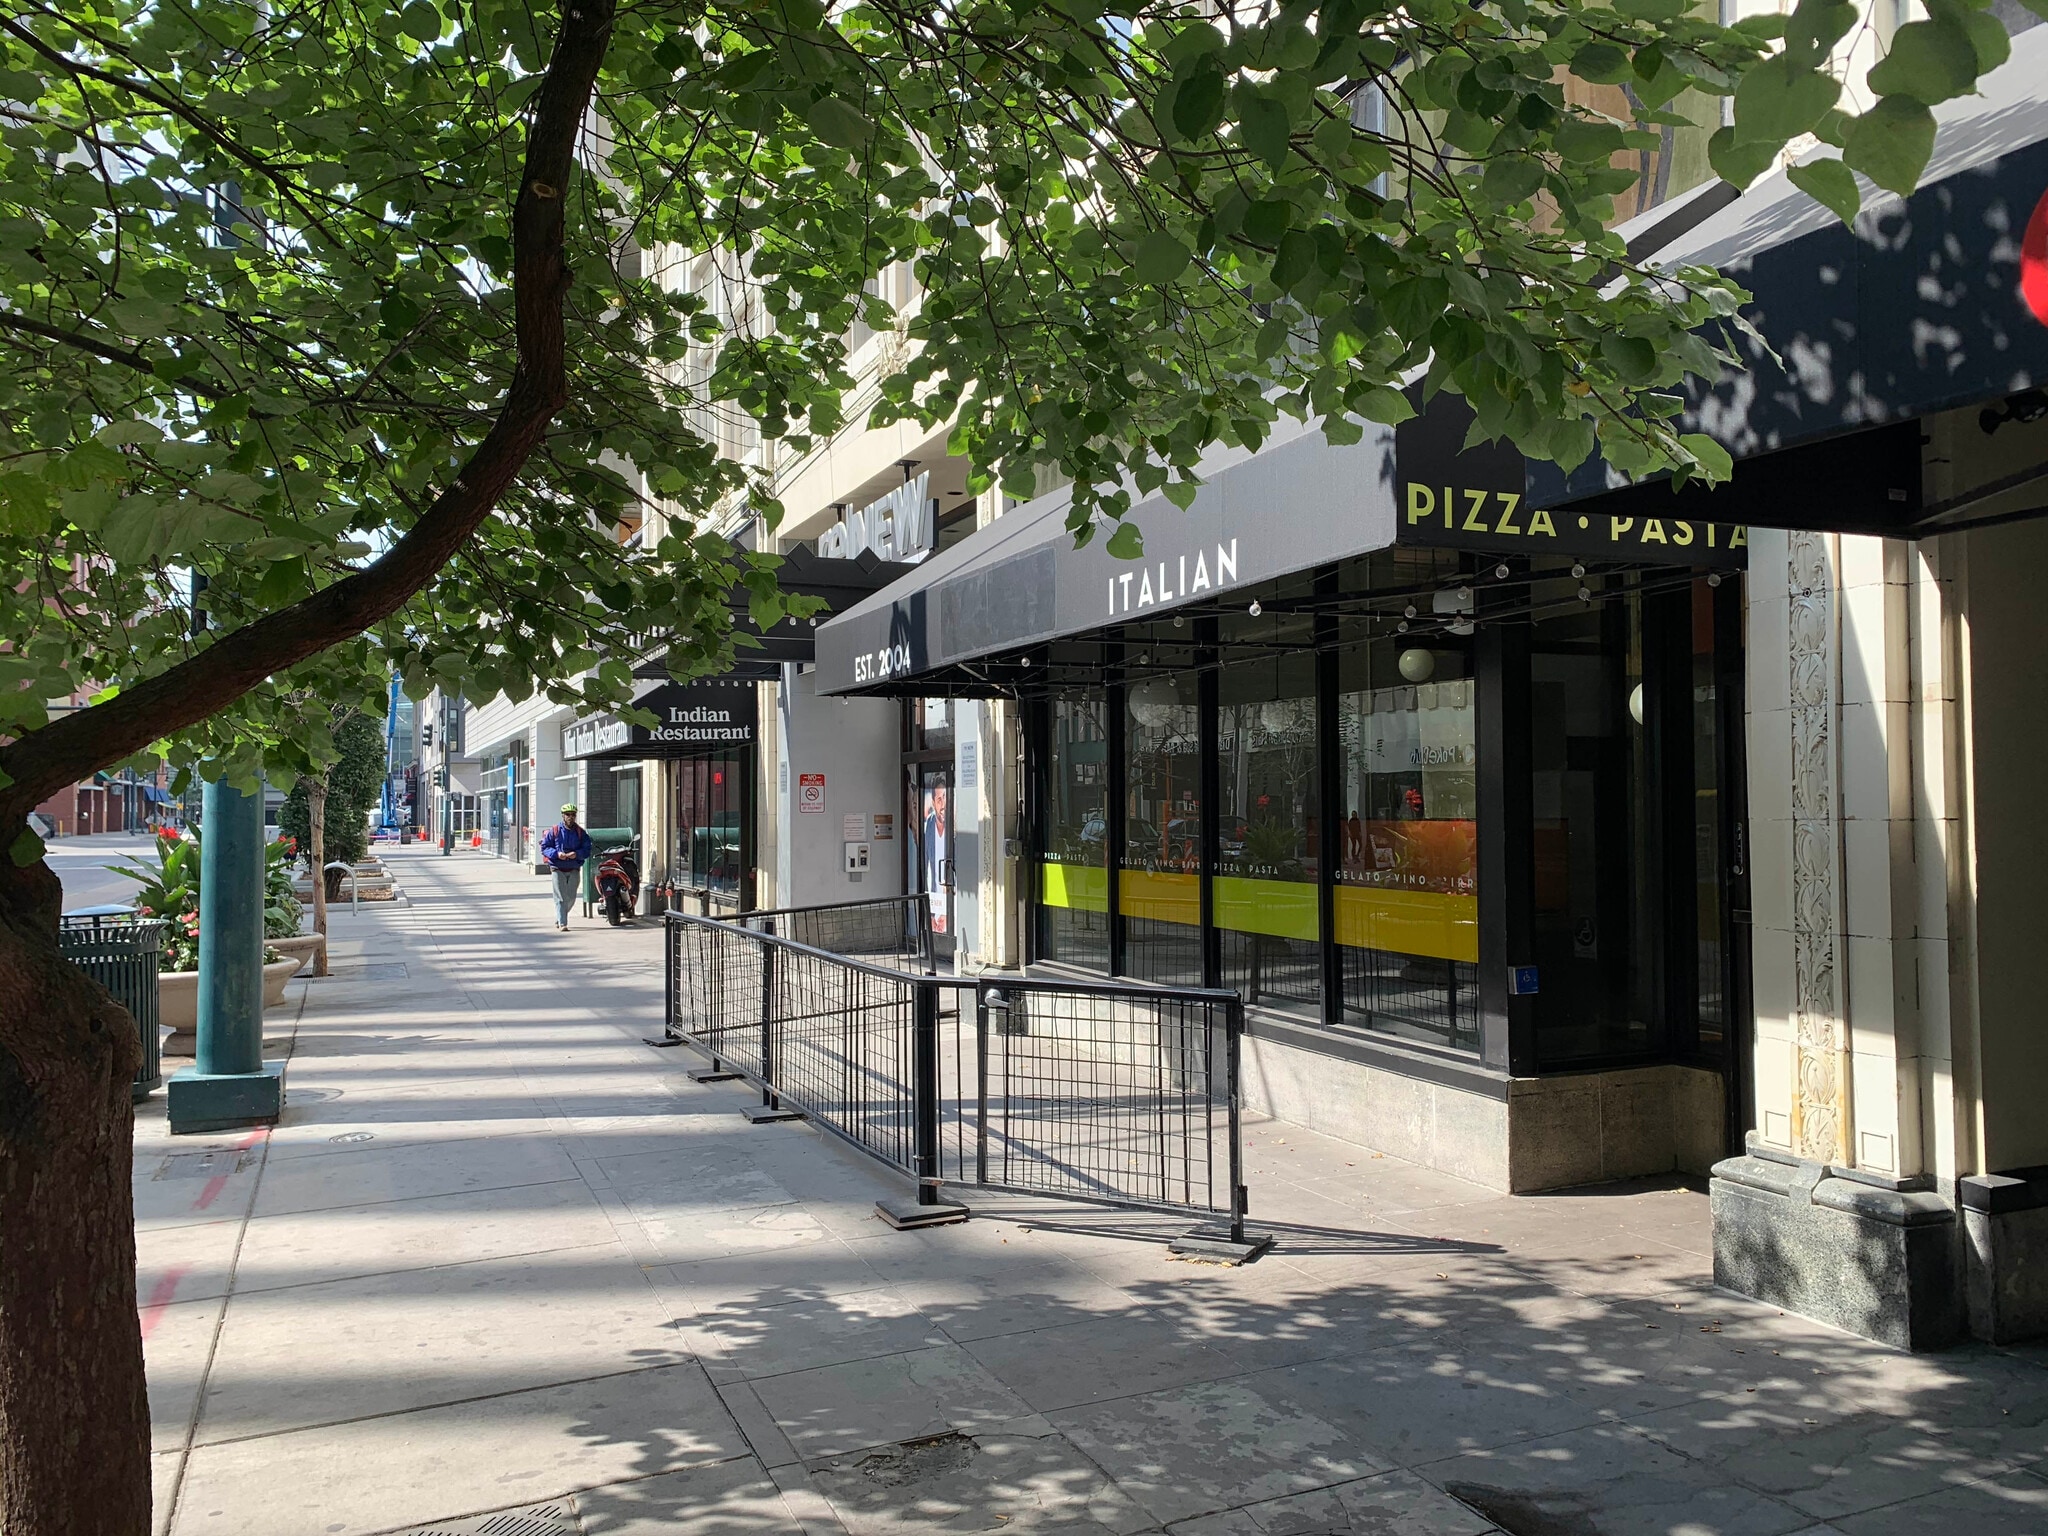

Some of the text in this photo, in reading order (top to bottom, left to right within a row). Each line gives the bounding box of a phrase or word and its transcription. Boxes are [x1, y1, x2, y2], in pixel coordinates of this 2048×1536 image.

[1407, 482, 1558, 538] PIZZA
[1109, 538, 1237, 615] ITALIAN
[855, 642, 911, 682] EST. 2004
[669, 706, 731, 723] Indian
[576, 724, 594, 756] Indian
[649, 724, 751, 741] Restaurant
[1044, 852, 1086, 862] PIZZA PASTA
[1119, 857, 1147, 866] GELATO
[1213, 862, 1278, 875] PIZZA PASTA
[1335, 870, 1380, 882] GELATO
[1394, 873, 1426, 885] VINO
